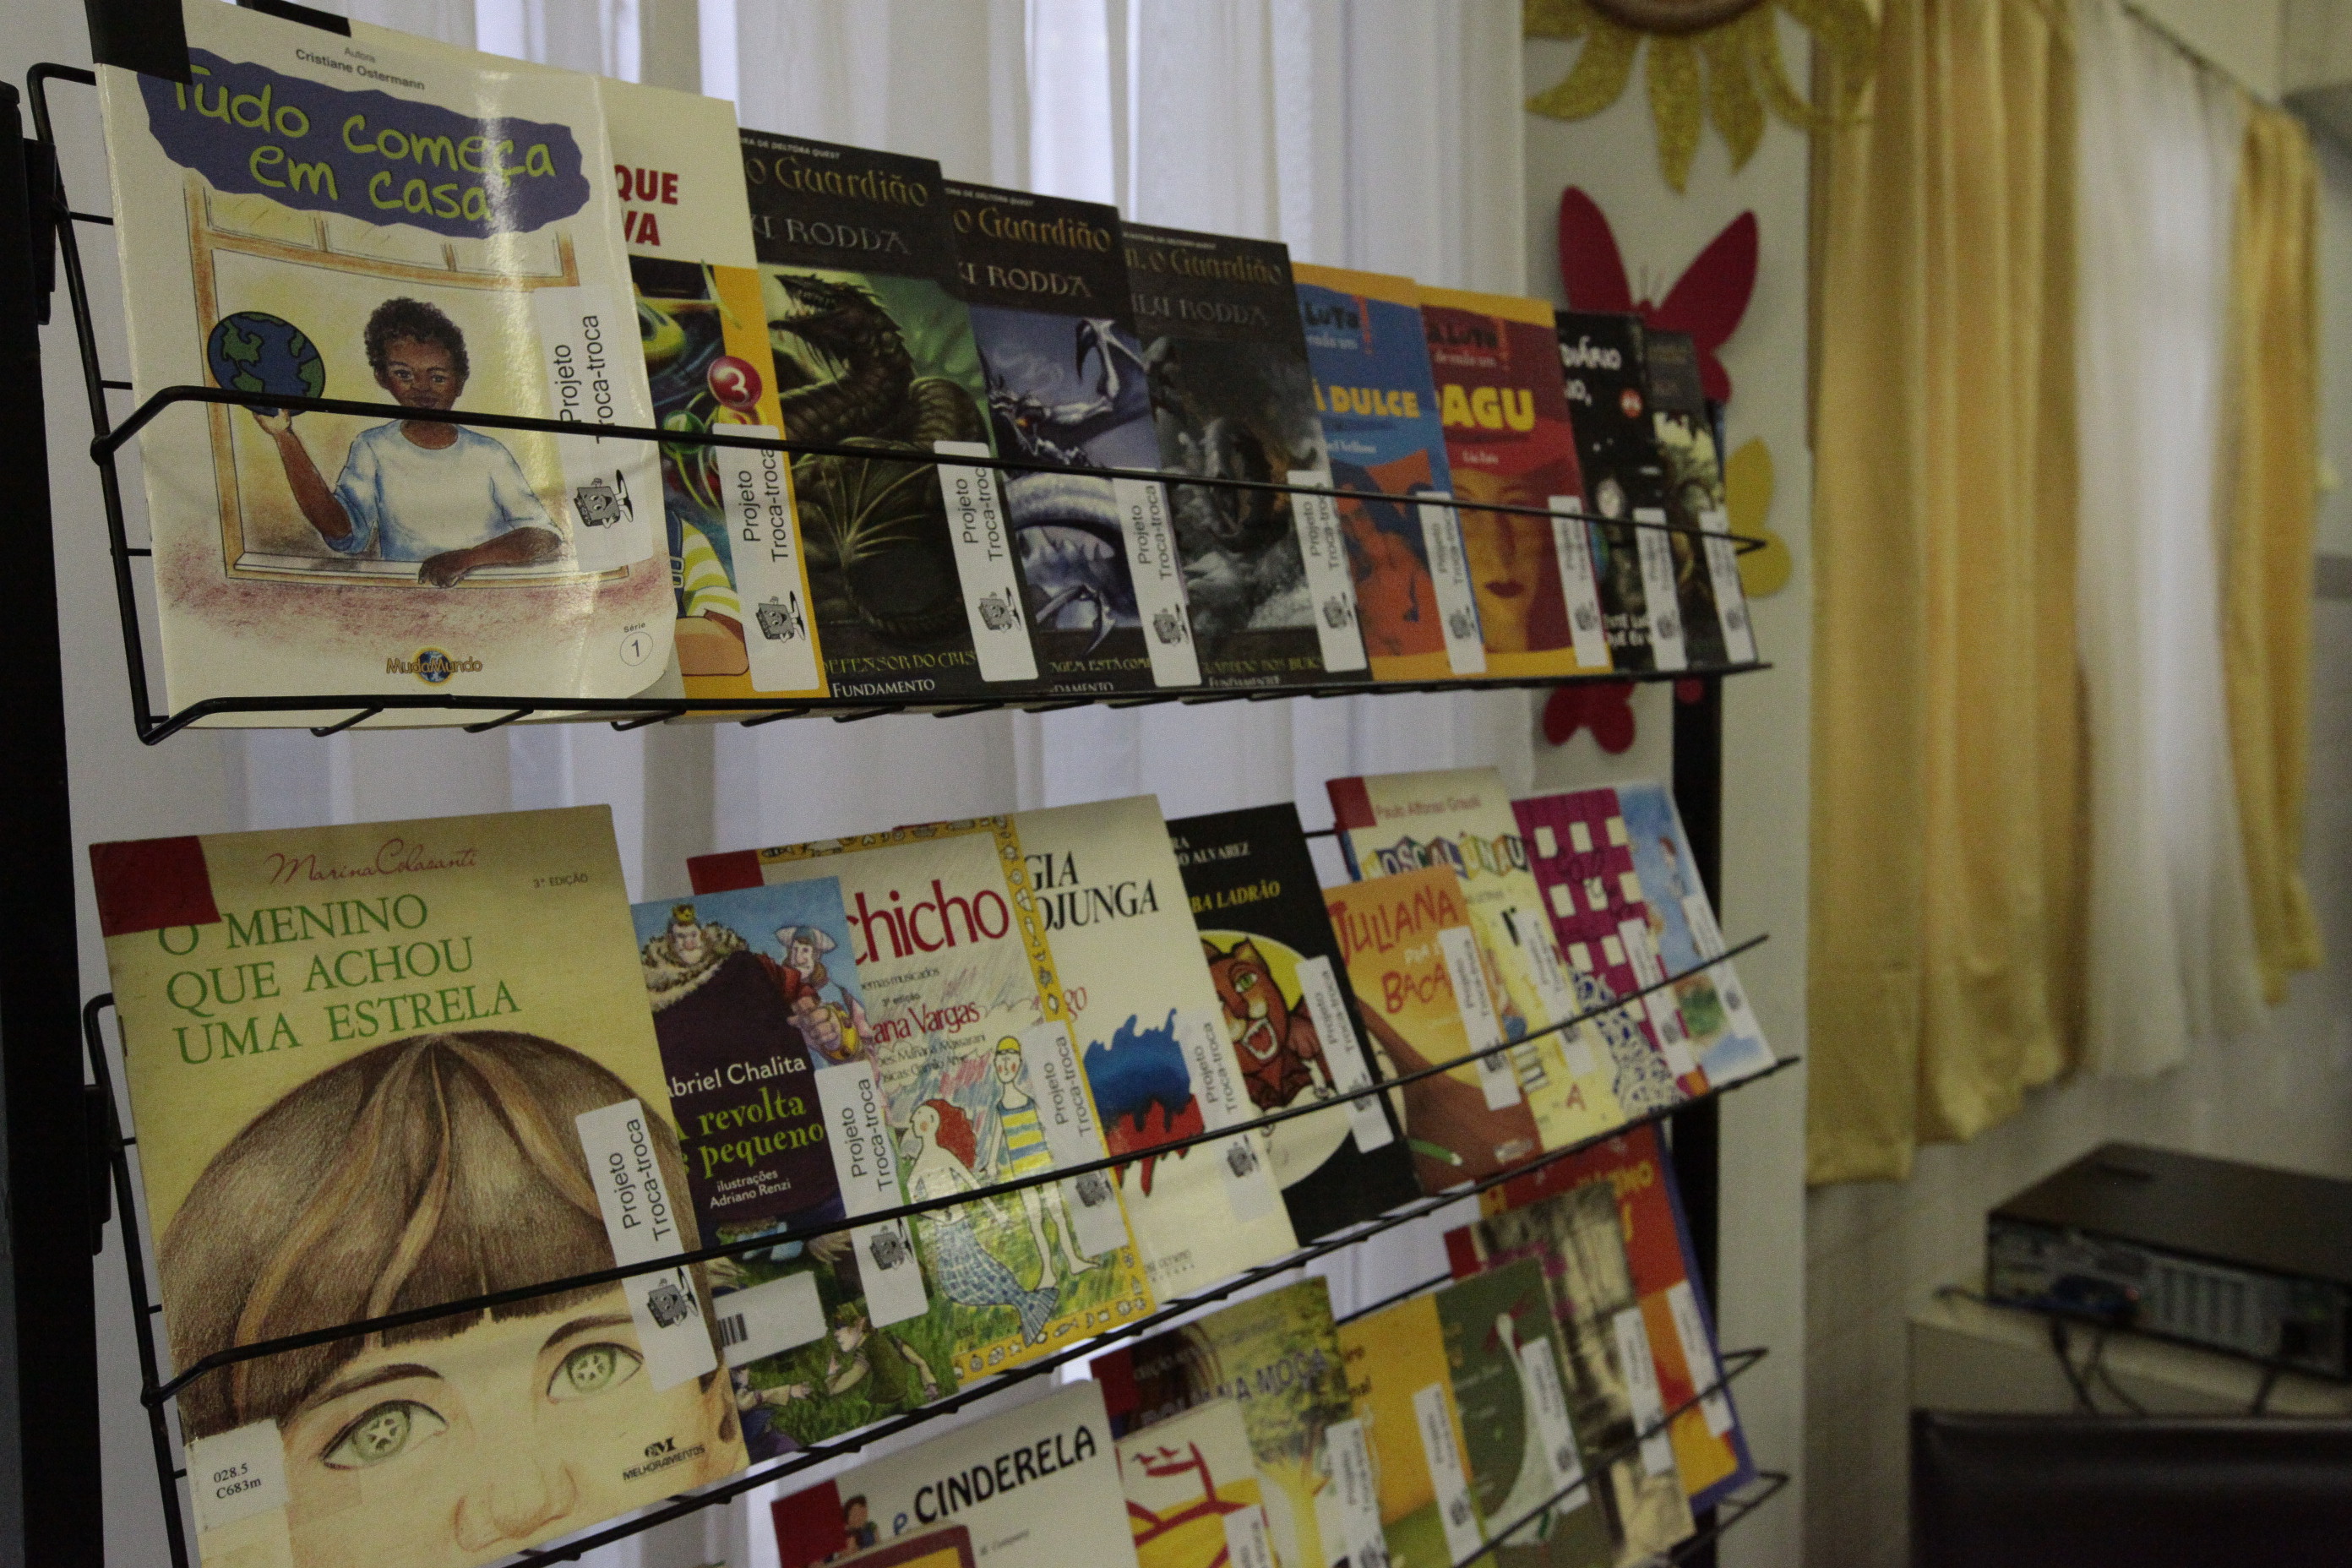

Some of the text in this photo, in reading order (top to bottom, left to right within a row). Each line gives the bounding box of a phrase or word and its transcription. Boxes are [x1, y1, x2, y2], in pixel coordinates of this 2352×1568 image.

[295, 48, 426, 91] Cristiane Ostermann
[249, 145, 338, 201] em
[774, 154, 928, 208] Guardião
[785, 217, 912, 255] RODDA
[977, 206, 1113, 253] Guardião
[987, 264, 1092, 298] RODDA
[553, 344, 582, 423] Projeto
[1329, 384, 1421, 419] DULCE
[1435, 383, 1536, 433] AGU
[738, 470, 762, 543] Projeto
[760, 448, 789, 564] Troca-troca
[956, 477, 979, 544] Projeto
[975, 466, 1004, 562] Troca-troc
[1132, 504, 1152, 565] Projeto
[1146, 485, 1172, 580] Troca-troca
[1303, 500, 1321, 558] Projeto
[831, 678, 936, 699] FUNDAMENTO
[221, 893, 428, 950] MENINO
[166, 935, 475, 1018] QUE ACHOU
[172, 979, 522, 1065] UMA ESTRELA
[907, 1000, 981, 1035] Vargas
[727, 1054, 808, 1086] Chalita
[1043, 1061, 1070, 1126] Projeto
[1055, 1035, 1092, 1138] Troca-troca
[1194, 1045, 1218, 1104] Projeto
[1203, 1021, 1239, 1114] Troca-troca
[696, 1086, 808, 1137] revolta
[858, 1078, 894, 1192] Troca-troca
[697, 1122, 825, 1180] pequeno
[841, 1107, 868, 1179] Projeto
[608, 1152, 642, 1230] Projeto
[626, 1118, 672, 1243] Troca-troca
[709, 1178, 792, 1210] Adriano Renzi
[213, 1462, 249, 1484] 028.5
[216, 1478, 263, 1500] C683m
[914, 1424, 1097, 1525] CINDERELA
